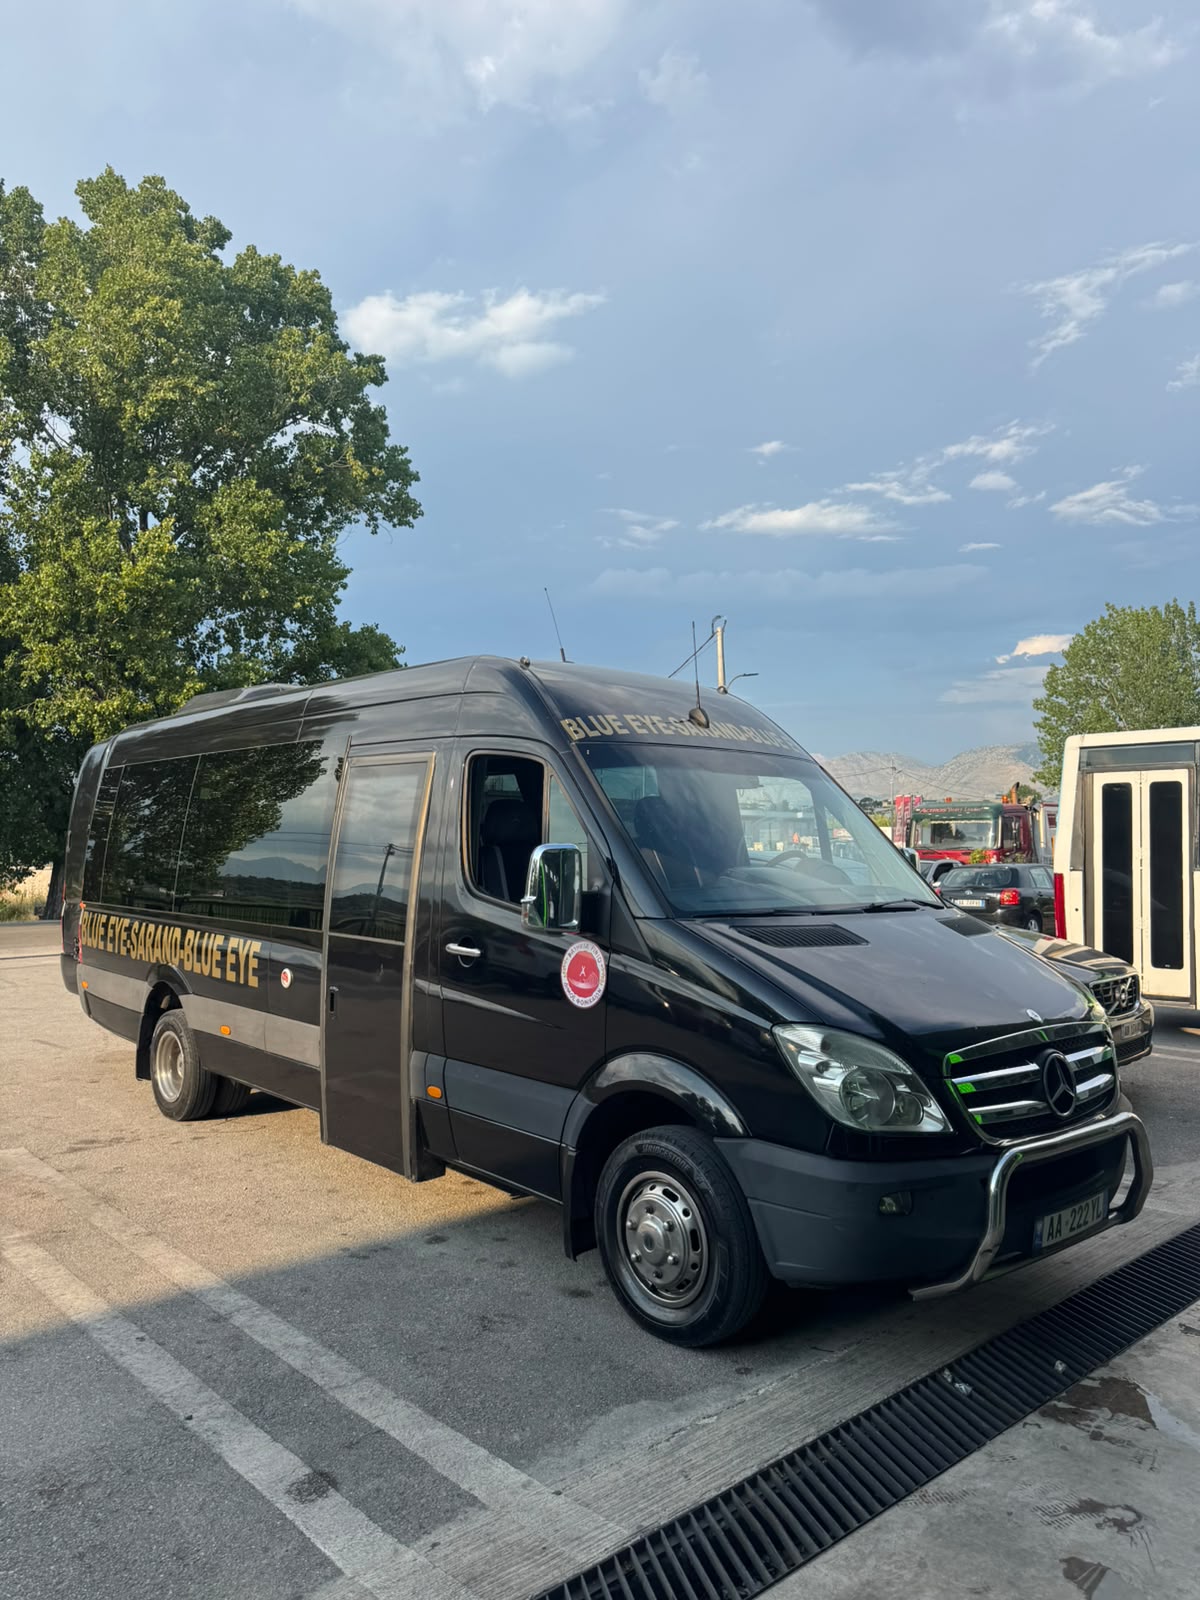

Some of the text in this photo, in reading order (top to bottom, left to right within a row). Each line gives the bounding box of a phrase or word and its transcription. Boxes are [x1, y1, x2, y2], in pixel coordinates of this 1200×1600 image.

[560, 714, 630, 741] BLUE
[81, 911, 107, 949] BLUE
[226, 937, 262, 988] EYE
[1047, 1213, 1062, 1242] AA
